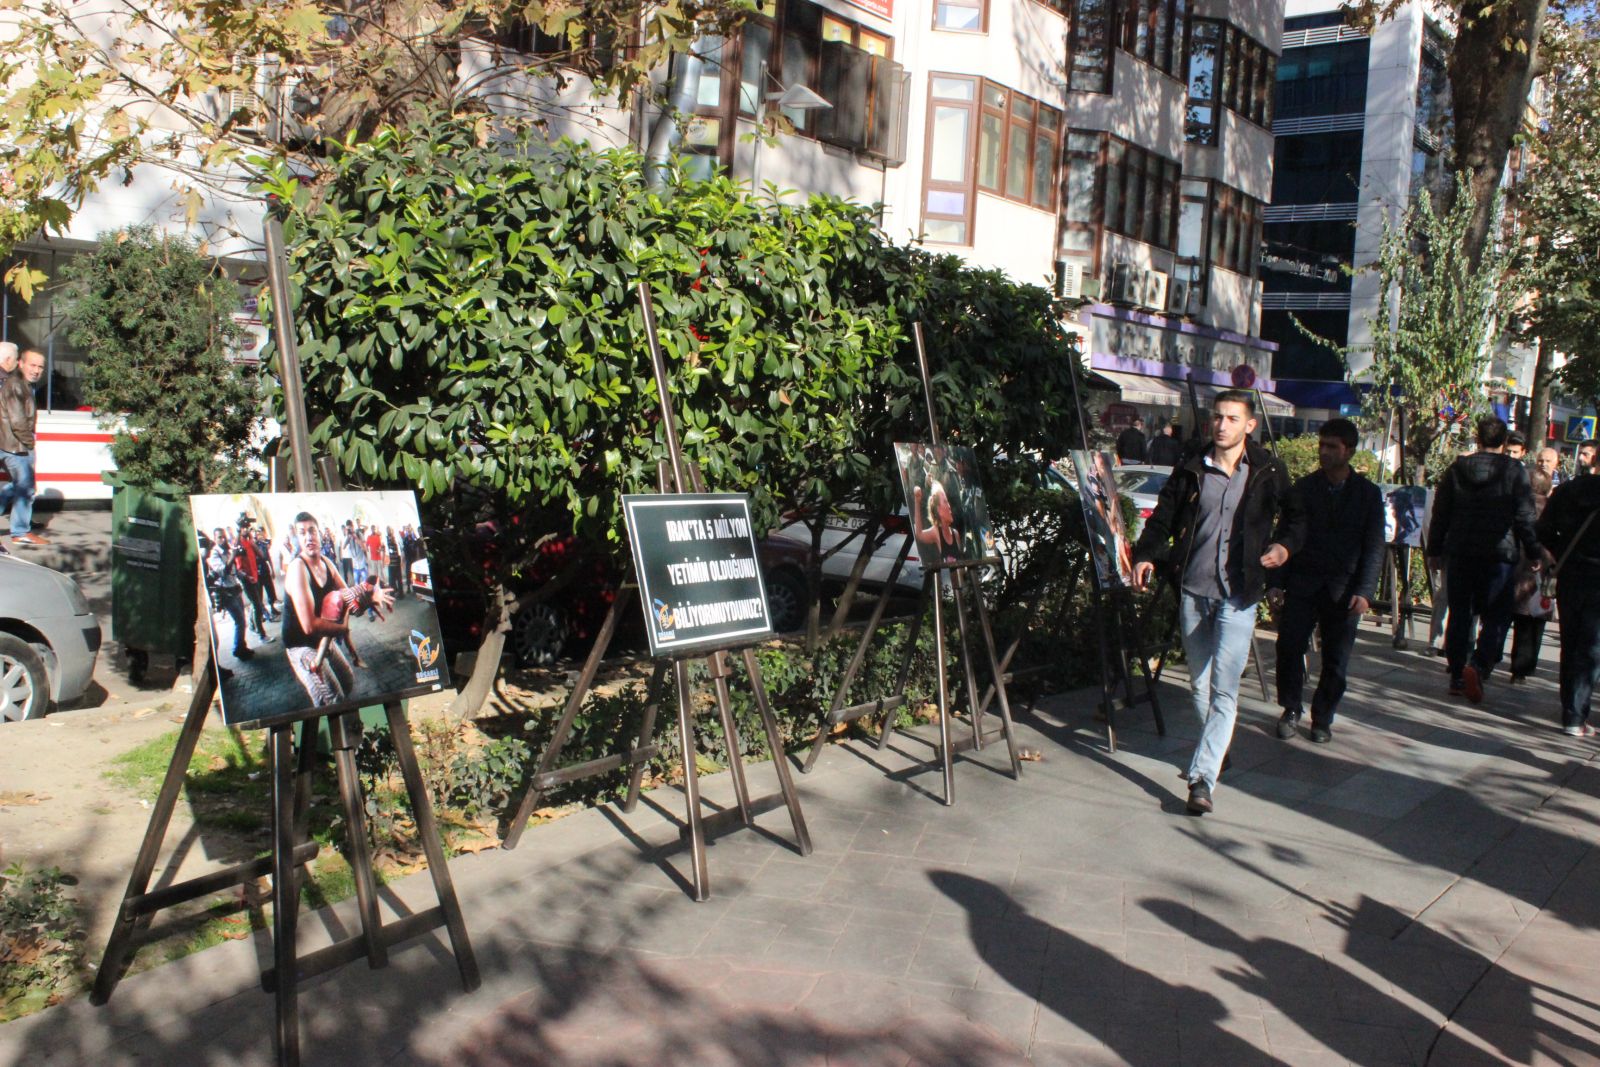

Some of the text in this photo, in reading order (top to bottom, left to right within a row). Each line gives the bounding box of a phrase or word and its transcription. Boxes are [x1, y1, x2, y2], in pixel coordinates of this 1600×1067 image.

[666, 514, 749, 542] IRAK'TA 5 MİLYON
[667, 553, 756, 585] YETİMİN OLDUĞUNU
[673, 597, 763, 629] BİLİYORMUYDUNUZ?
